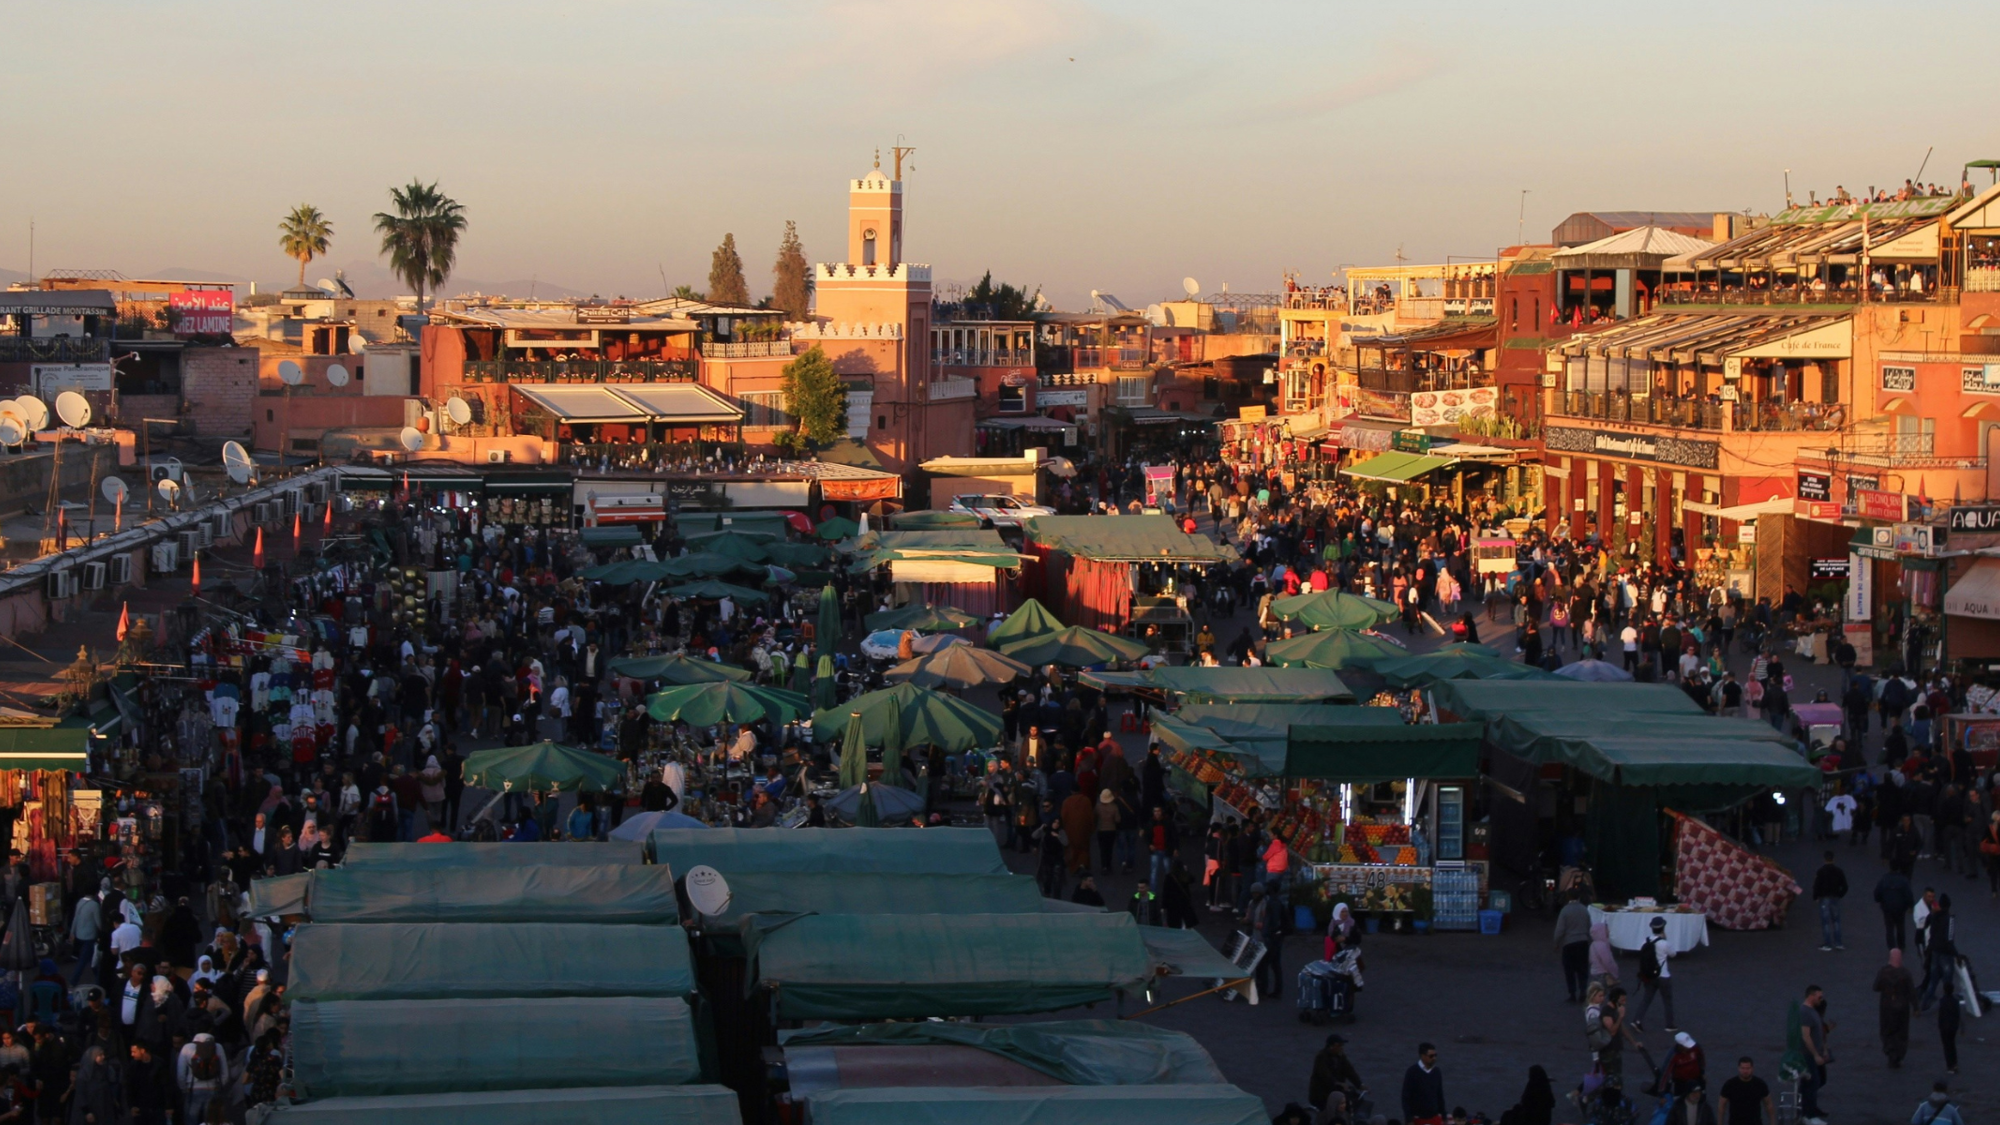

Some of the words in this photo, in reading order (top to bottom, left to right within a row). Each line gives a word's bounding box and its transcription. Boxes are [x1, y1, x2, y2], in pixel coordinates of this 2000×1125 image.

[1774, 207, 1828, 223] CAFE
[1865, 199, 1950, 217] FRANCE
[23, 306, 61, 314] GRILLADE
[62, 307, 108, 315] MONTASSIR
[208, 297, 230, 311] عند
[173, 316, 196, 333] CHEZ
[197, 316, 230, 333] LAMINE
[1781, 340, 1800, 352] Café
[1802, 341, 1811, 349] de
[1814, 341, 1841, 349] France
[1866, 492, 1875, 503] LES
[1875, 493, 1889, 508] CINQ
[1883, 508, 1901, 519] CENTER
[1952, 511, 2000, 528] AQUA
[1964, 602, 1989, 615] AQUA
[1366, 871, 1386, 890] 48
